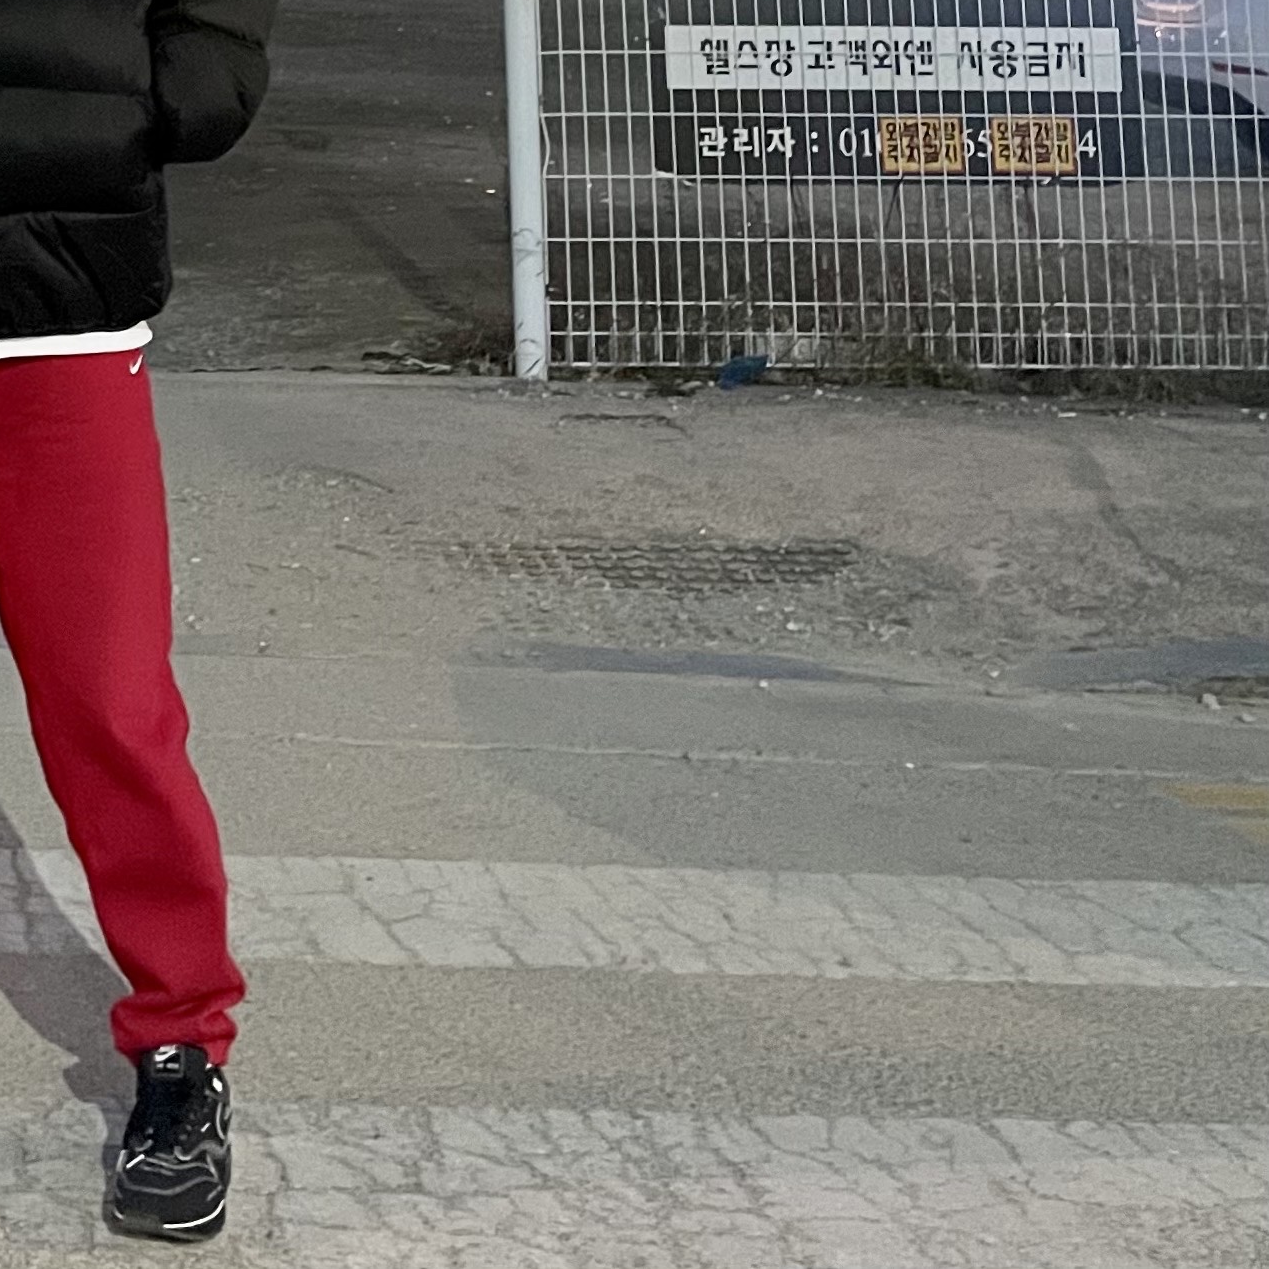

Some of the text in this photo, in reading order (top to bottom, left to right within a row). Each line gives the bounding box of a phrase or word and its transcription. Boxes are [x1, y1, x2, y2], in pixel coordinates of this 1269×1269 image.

[700, 38, 794, 78] 헬스장
[957, 39, 1086, 79] 사용금지
[699, 126, 797, 158] 관리자
